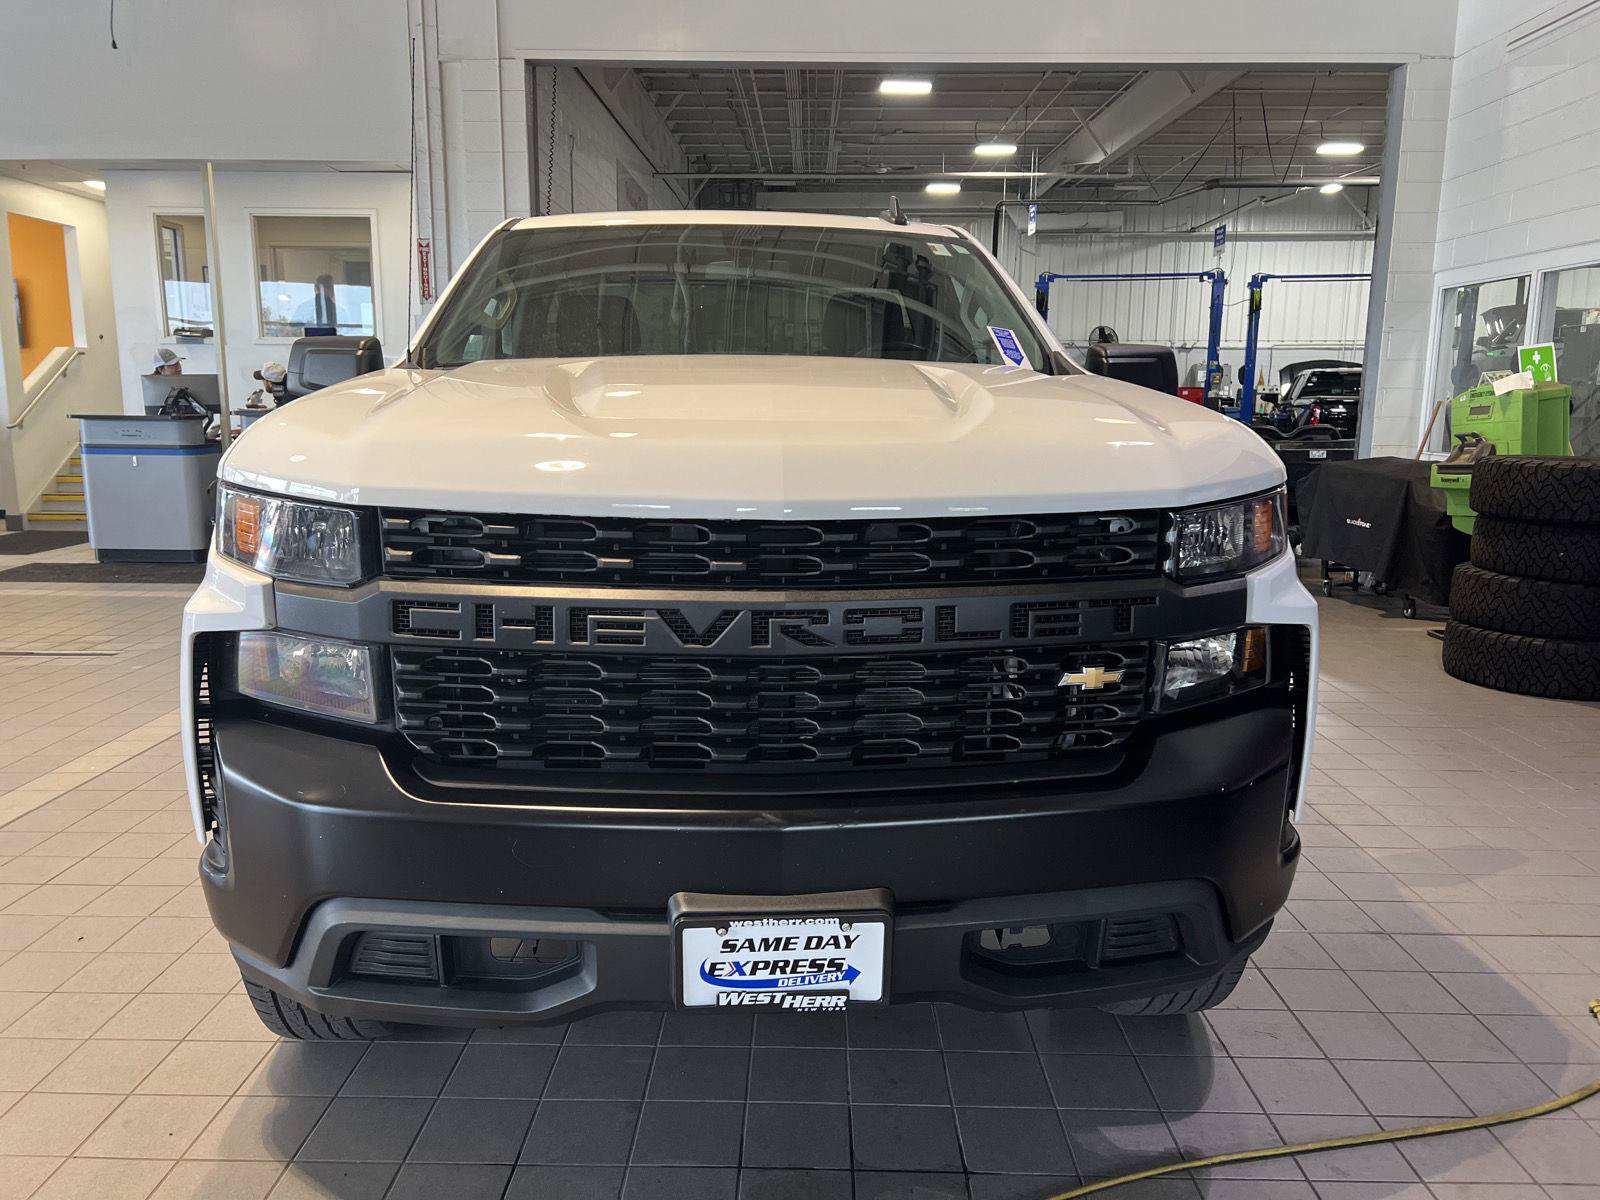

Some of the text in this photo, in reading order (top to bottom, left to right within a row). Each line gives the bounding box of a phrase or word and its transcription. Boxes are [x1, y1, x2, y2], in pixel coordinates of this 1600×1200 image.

[392, 596, 1159, 649] CHEVROLET
[729, 918, 840, 928] westherr.com
[720, 934, 860, 954] SAME DAY
[708, 957, 846, 977] EXPRESS
[777, 971, 846, 987] DELIVERY
